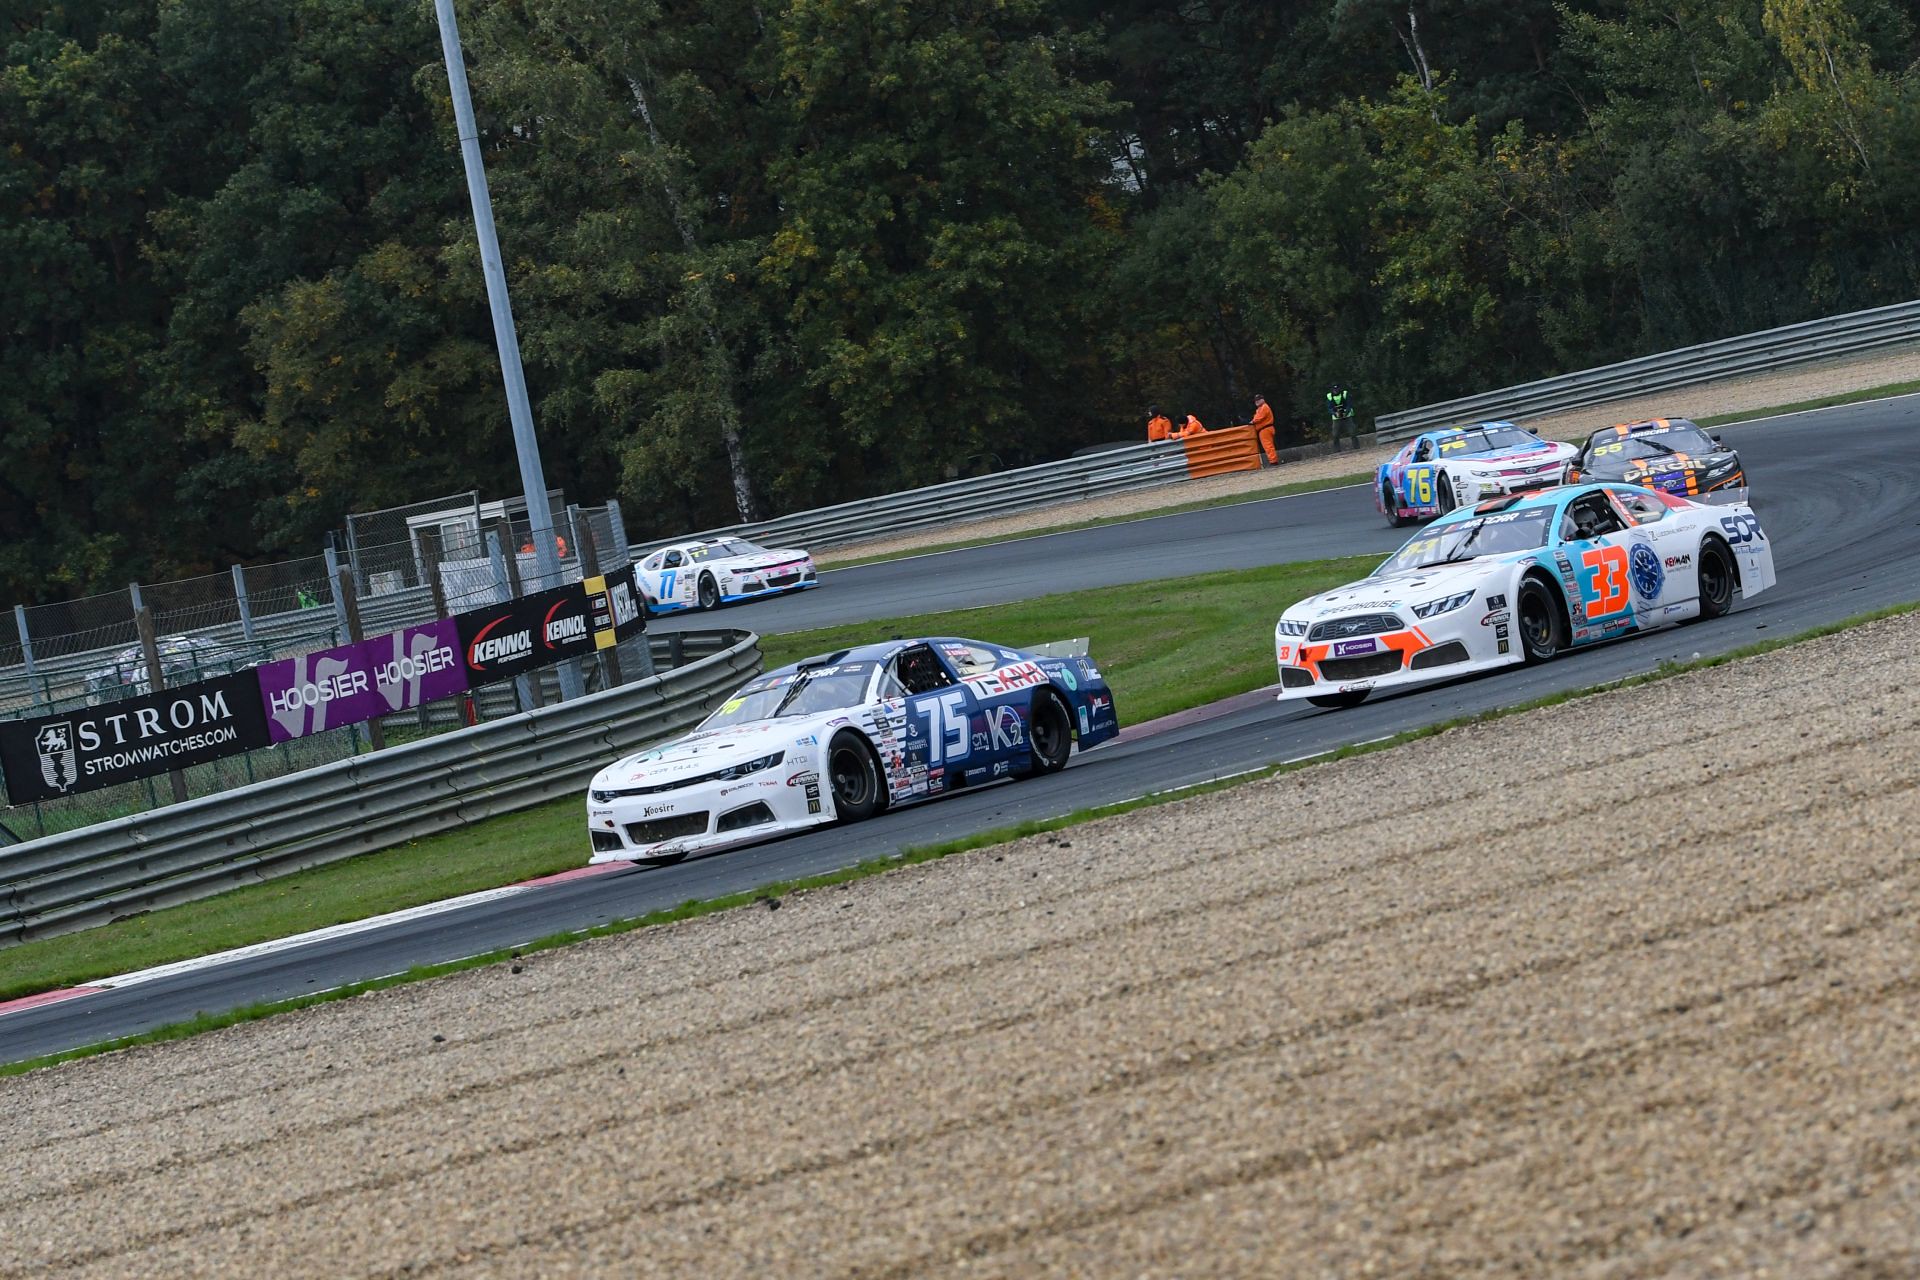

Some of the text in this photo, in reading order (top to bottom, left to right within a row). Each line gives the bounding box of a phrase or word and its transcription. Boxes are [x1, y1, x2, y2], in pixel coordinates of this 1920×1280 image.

[1593, 443, 1623, 457] 55
[1407, 468, 1432, 503] 76
[1665, 554, 1691, 568] KEYMAN
[660, 570, 677, 599] 77
[1581, 544, 1630, 620] 33
[546, 614, 587, 642] KENNOL
[473, 629, 533, 664] KENNOL
[1280, 646, 1290, 659] 33
[375, 645, 455, 689] HOOSIER
[269, 669, 369, 714] HOOSIER
[78, 690, 234, 751] STROM
[914, 692, 969, 764] 75
[84, 725, 237, 775] STROMWATCHES.COM
